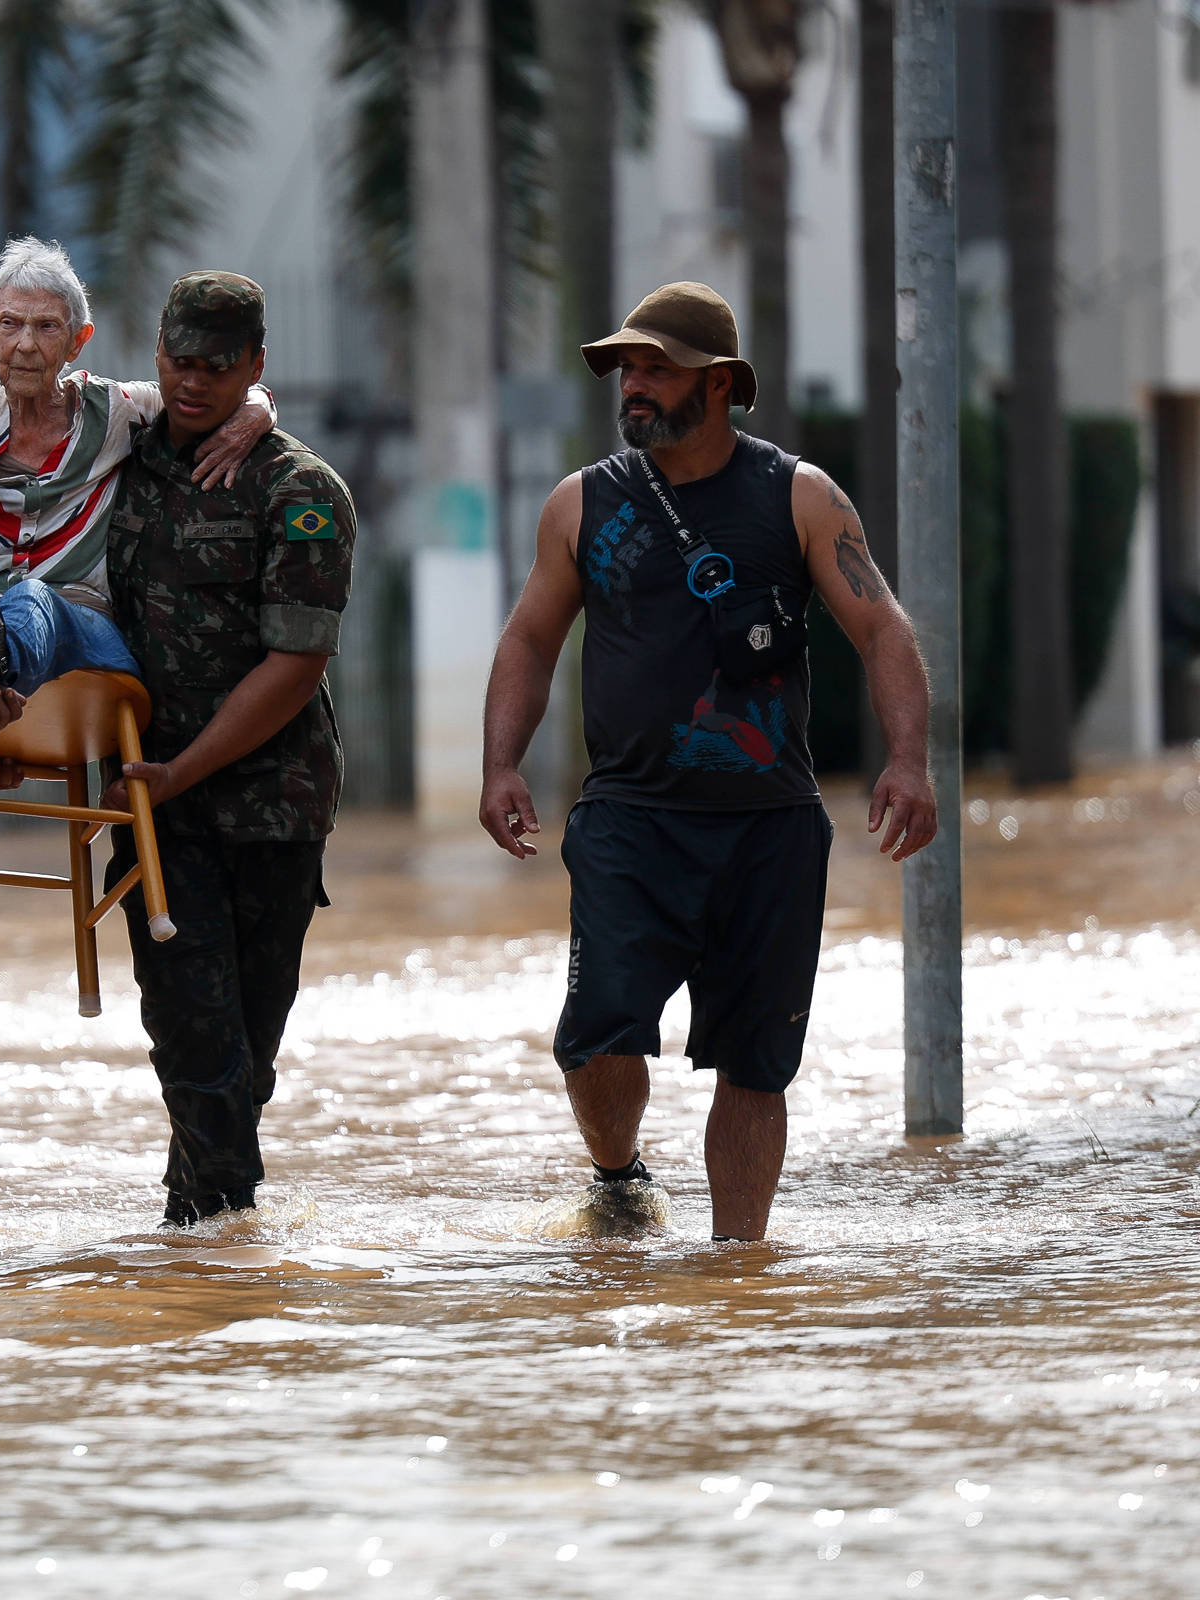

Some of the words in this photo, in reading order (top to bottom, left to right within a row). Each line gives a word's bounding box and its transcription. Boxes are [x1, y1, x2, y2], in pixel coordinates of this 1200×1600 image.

[638, 450, 654, 480] LACOSTE
[657, 491, 681, 526] LACOSTE
[568, 937, 581, 994] NIKE
